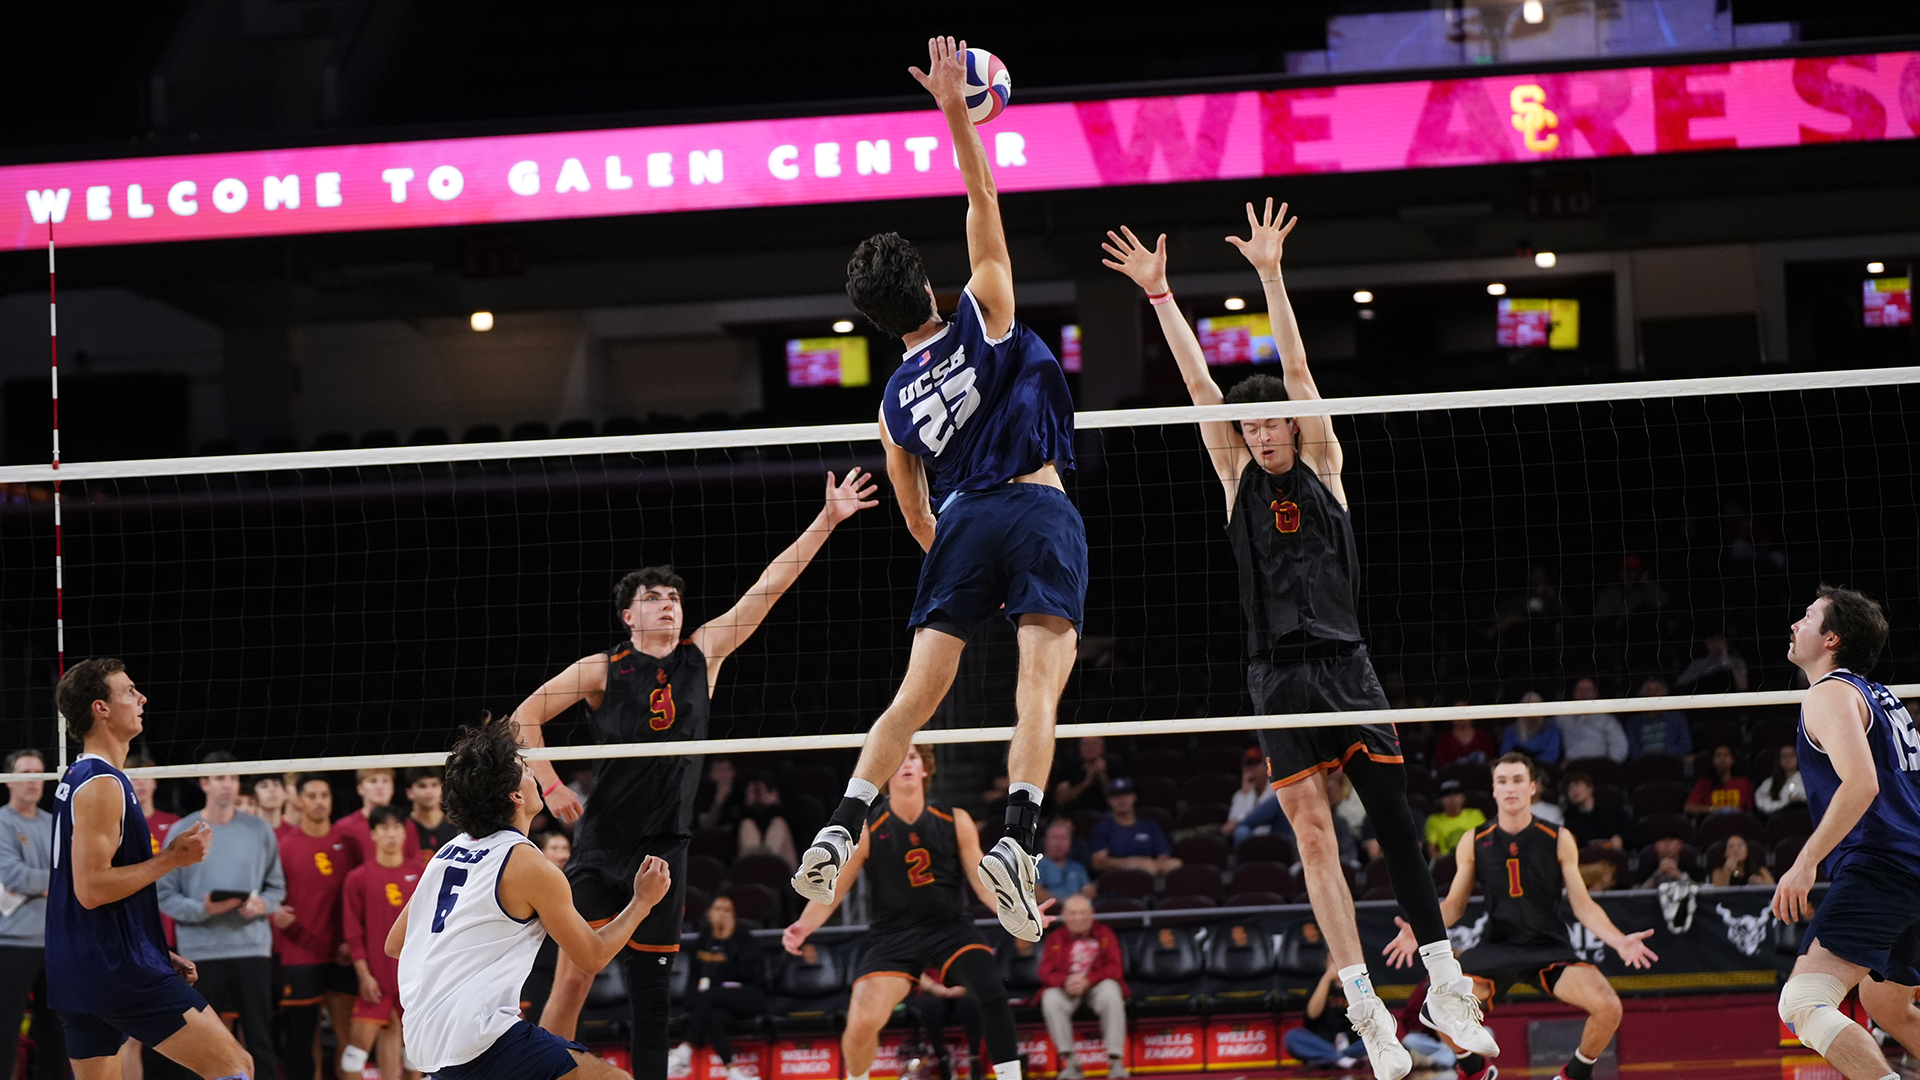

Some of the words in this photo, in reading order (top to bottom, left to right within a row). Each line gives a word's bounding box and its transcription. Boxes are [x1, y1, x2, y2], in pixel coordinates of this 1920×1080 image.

[1073, 86, 1342, 185] WE
[1404, 64, 1738, 168] ARE
[25, 171, 344, 224] WELCOME
[381, 166, 465, 203] TO
[507, 148, 725, 196] GALEN
[767, 131, 1027, 181] CENTR
[899, 344, 966, 408] UCSB
[649, 683, 676, 731] 9
[904, 847, 936, 887] 2
[1506, 858, 1524, 898] 1
[430, 865, 468, 934] 6
[780, 1048, 831, 1061] WELLS
[1144, 1033, 1194, 1046] WELLS
[1144, 1046, 1194, 1060] FARGO
[1216, 1030, 1267, 1043] WELLS
[1217, 1042, 1268, 1057] FARGO
[780, 1061, 831, 1075] FARGO
